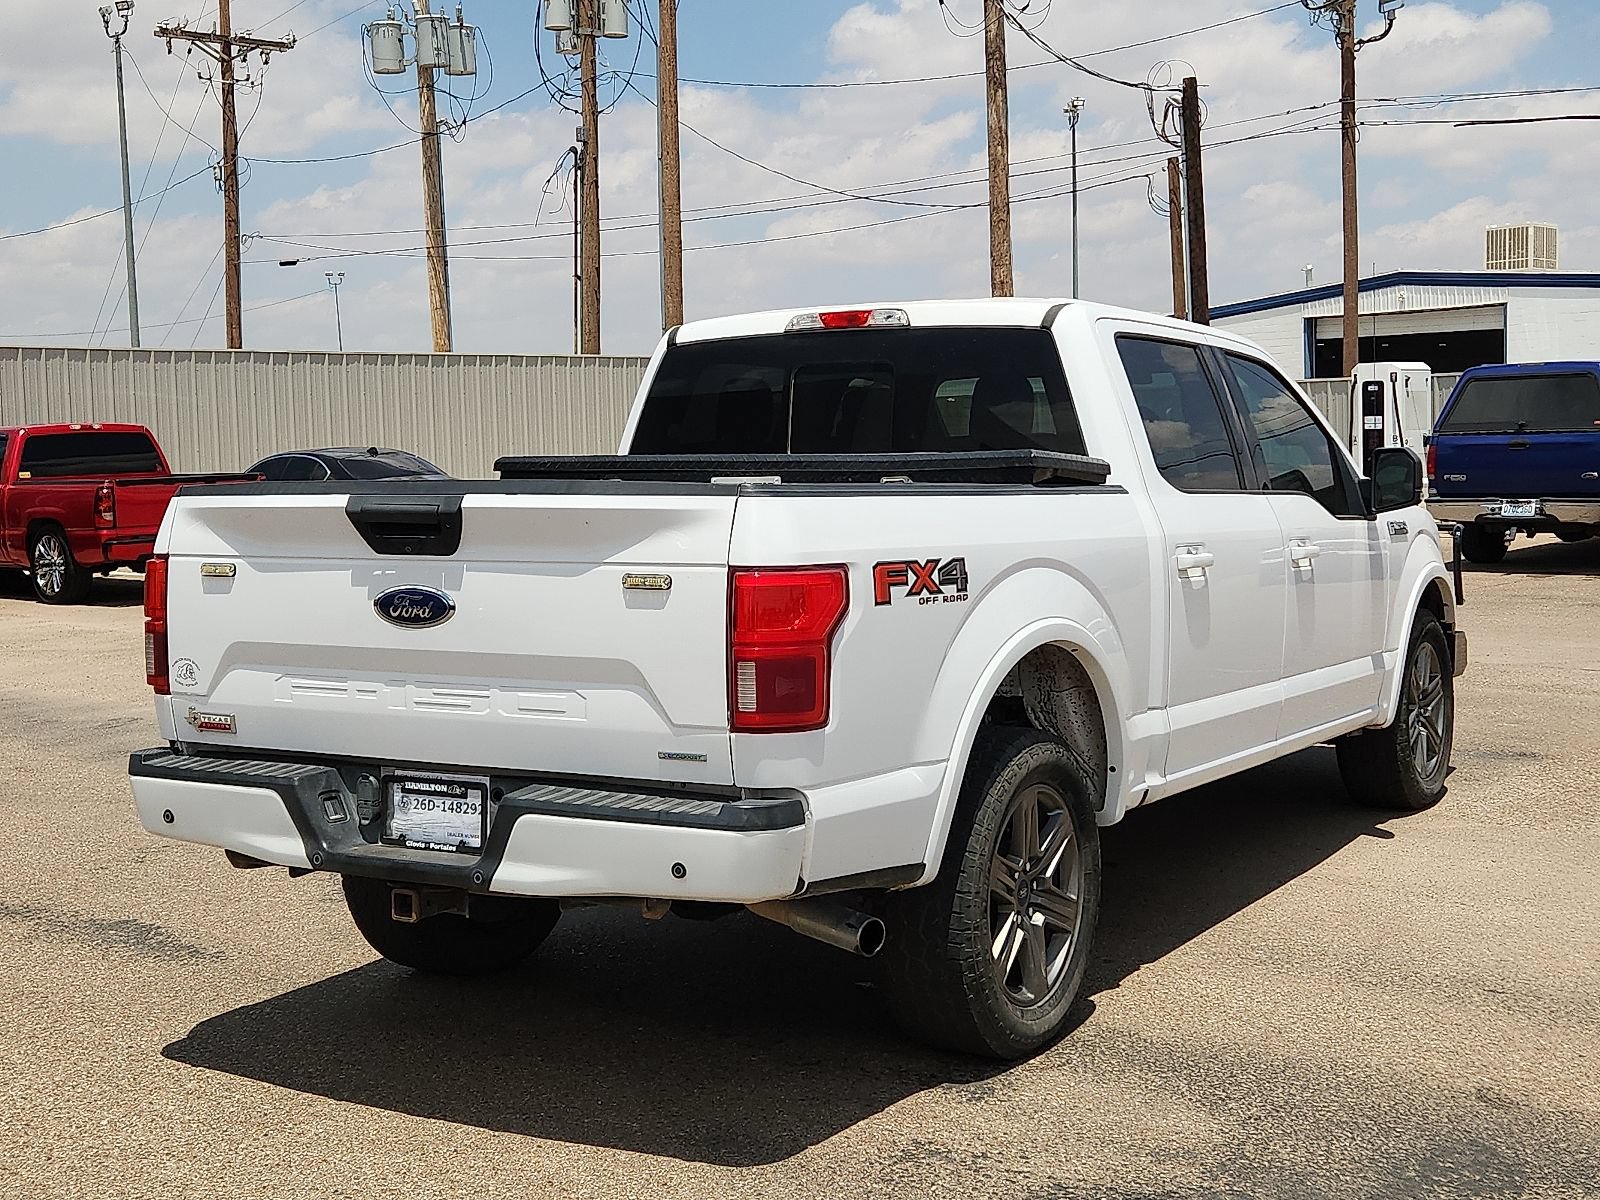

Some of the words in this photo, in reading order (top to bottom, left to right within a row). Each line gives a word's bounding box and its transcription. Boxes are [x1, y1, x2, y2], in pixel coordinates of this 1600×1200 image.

[872, 557, 969, 606] FX4
[389, 593, 436, 619] Ford
[918, 596, 939, 606] OFF
[942, 594, 969, 604] ROAD
[404, 781, 447, 793] HAMILTON
[405, 840, 426, 848] Clovis
[429, 843, 457, 852] Portales
